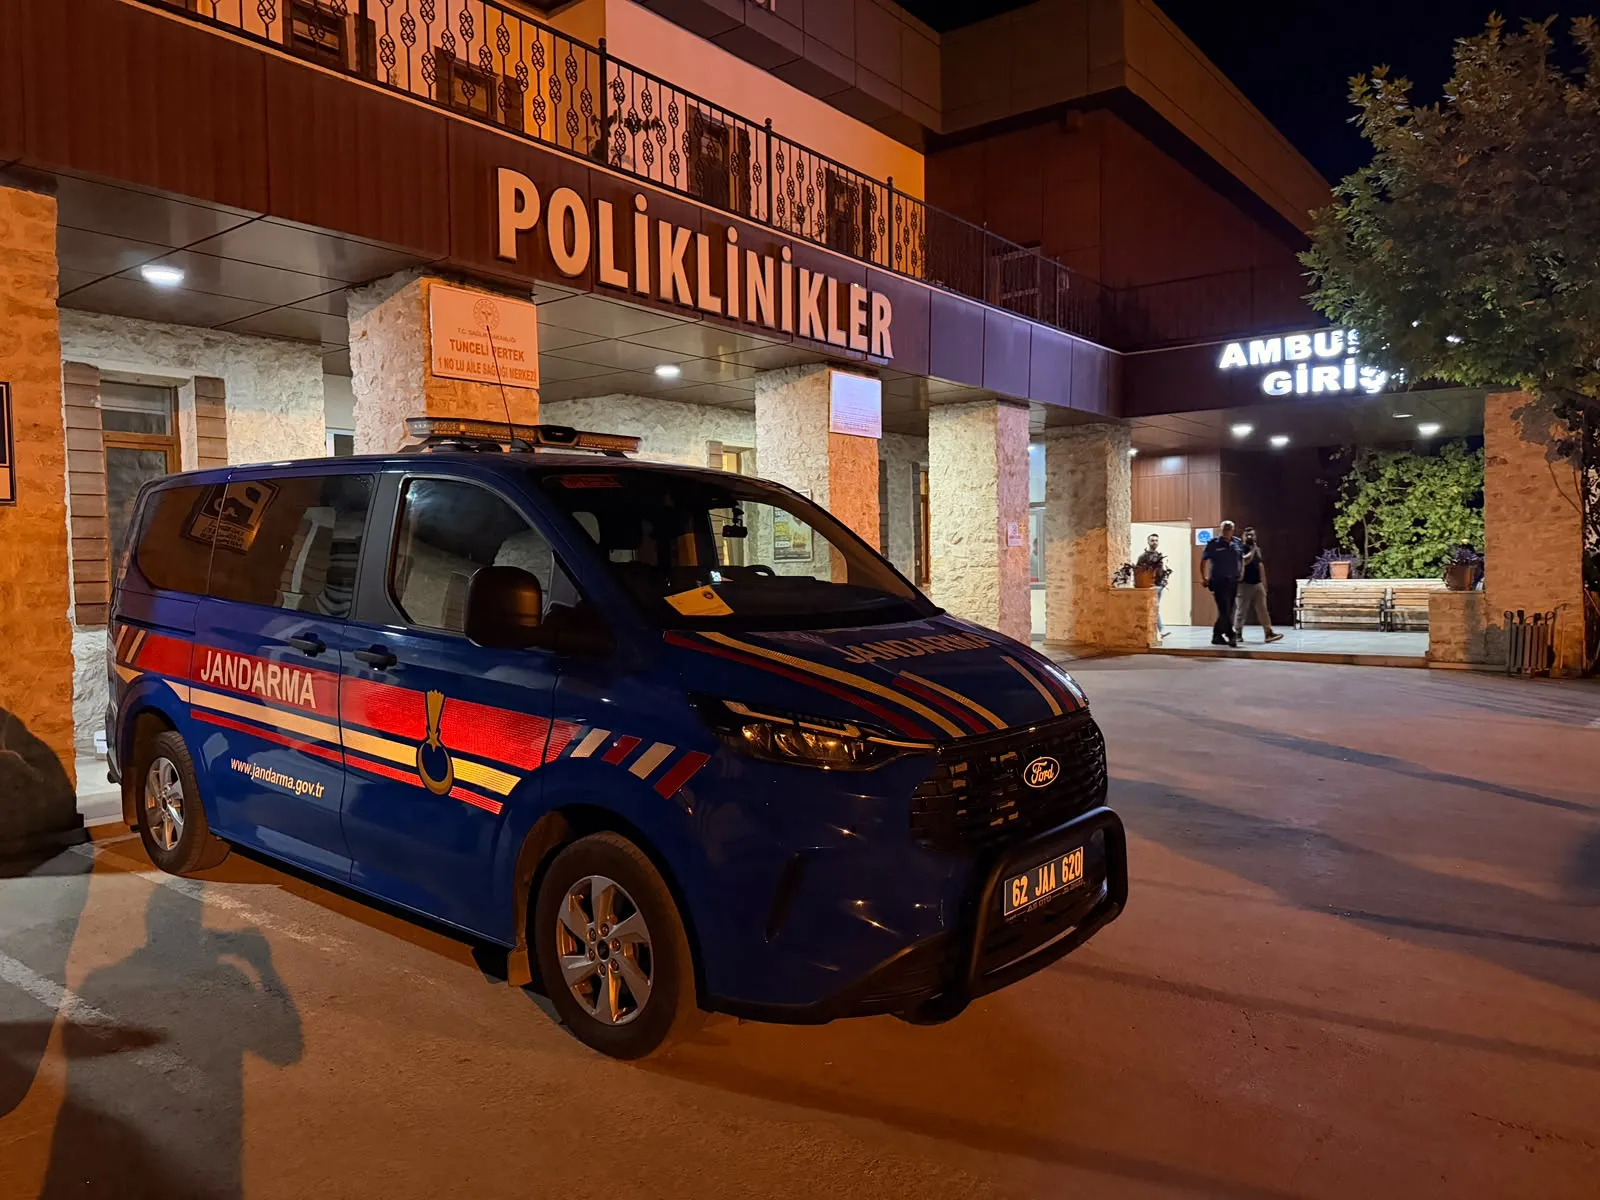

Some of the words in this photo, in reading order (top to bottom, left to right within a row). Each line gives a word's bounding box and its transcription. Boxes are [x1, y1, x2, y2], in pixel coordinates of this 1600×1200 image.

[497, 167, 894, 359] POLİKLİNİKLER
[449, 339, 489, 356] TUNCELİ
[466, 359, 481, 375] AİLE
[482, 362, 508, 379] SAĞIĞI
[510, 367, 537, 382] MERKEZİ
[844, 632, 992, 664] JANDARMA
[201, 650, 317, 709] JANDARMA
[230, 757, 325, 798] www.jandarma.gov.tr
[1030, 760, 1055, 785] Ford
[1012, 875, 1029, 907] 62
[1035, 862, 1056, 897] JAA
[1061, 851, 1081, 884] 620
